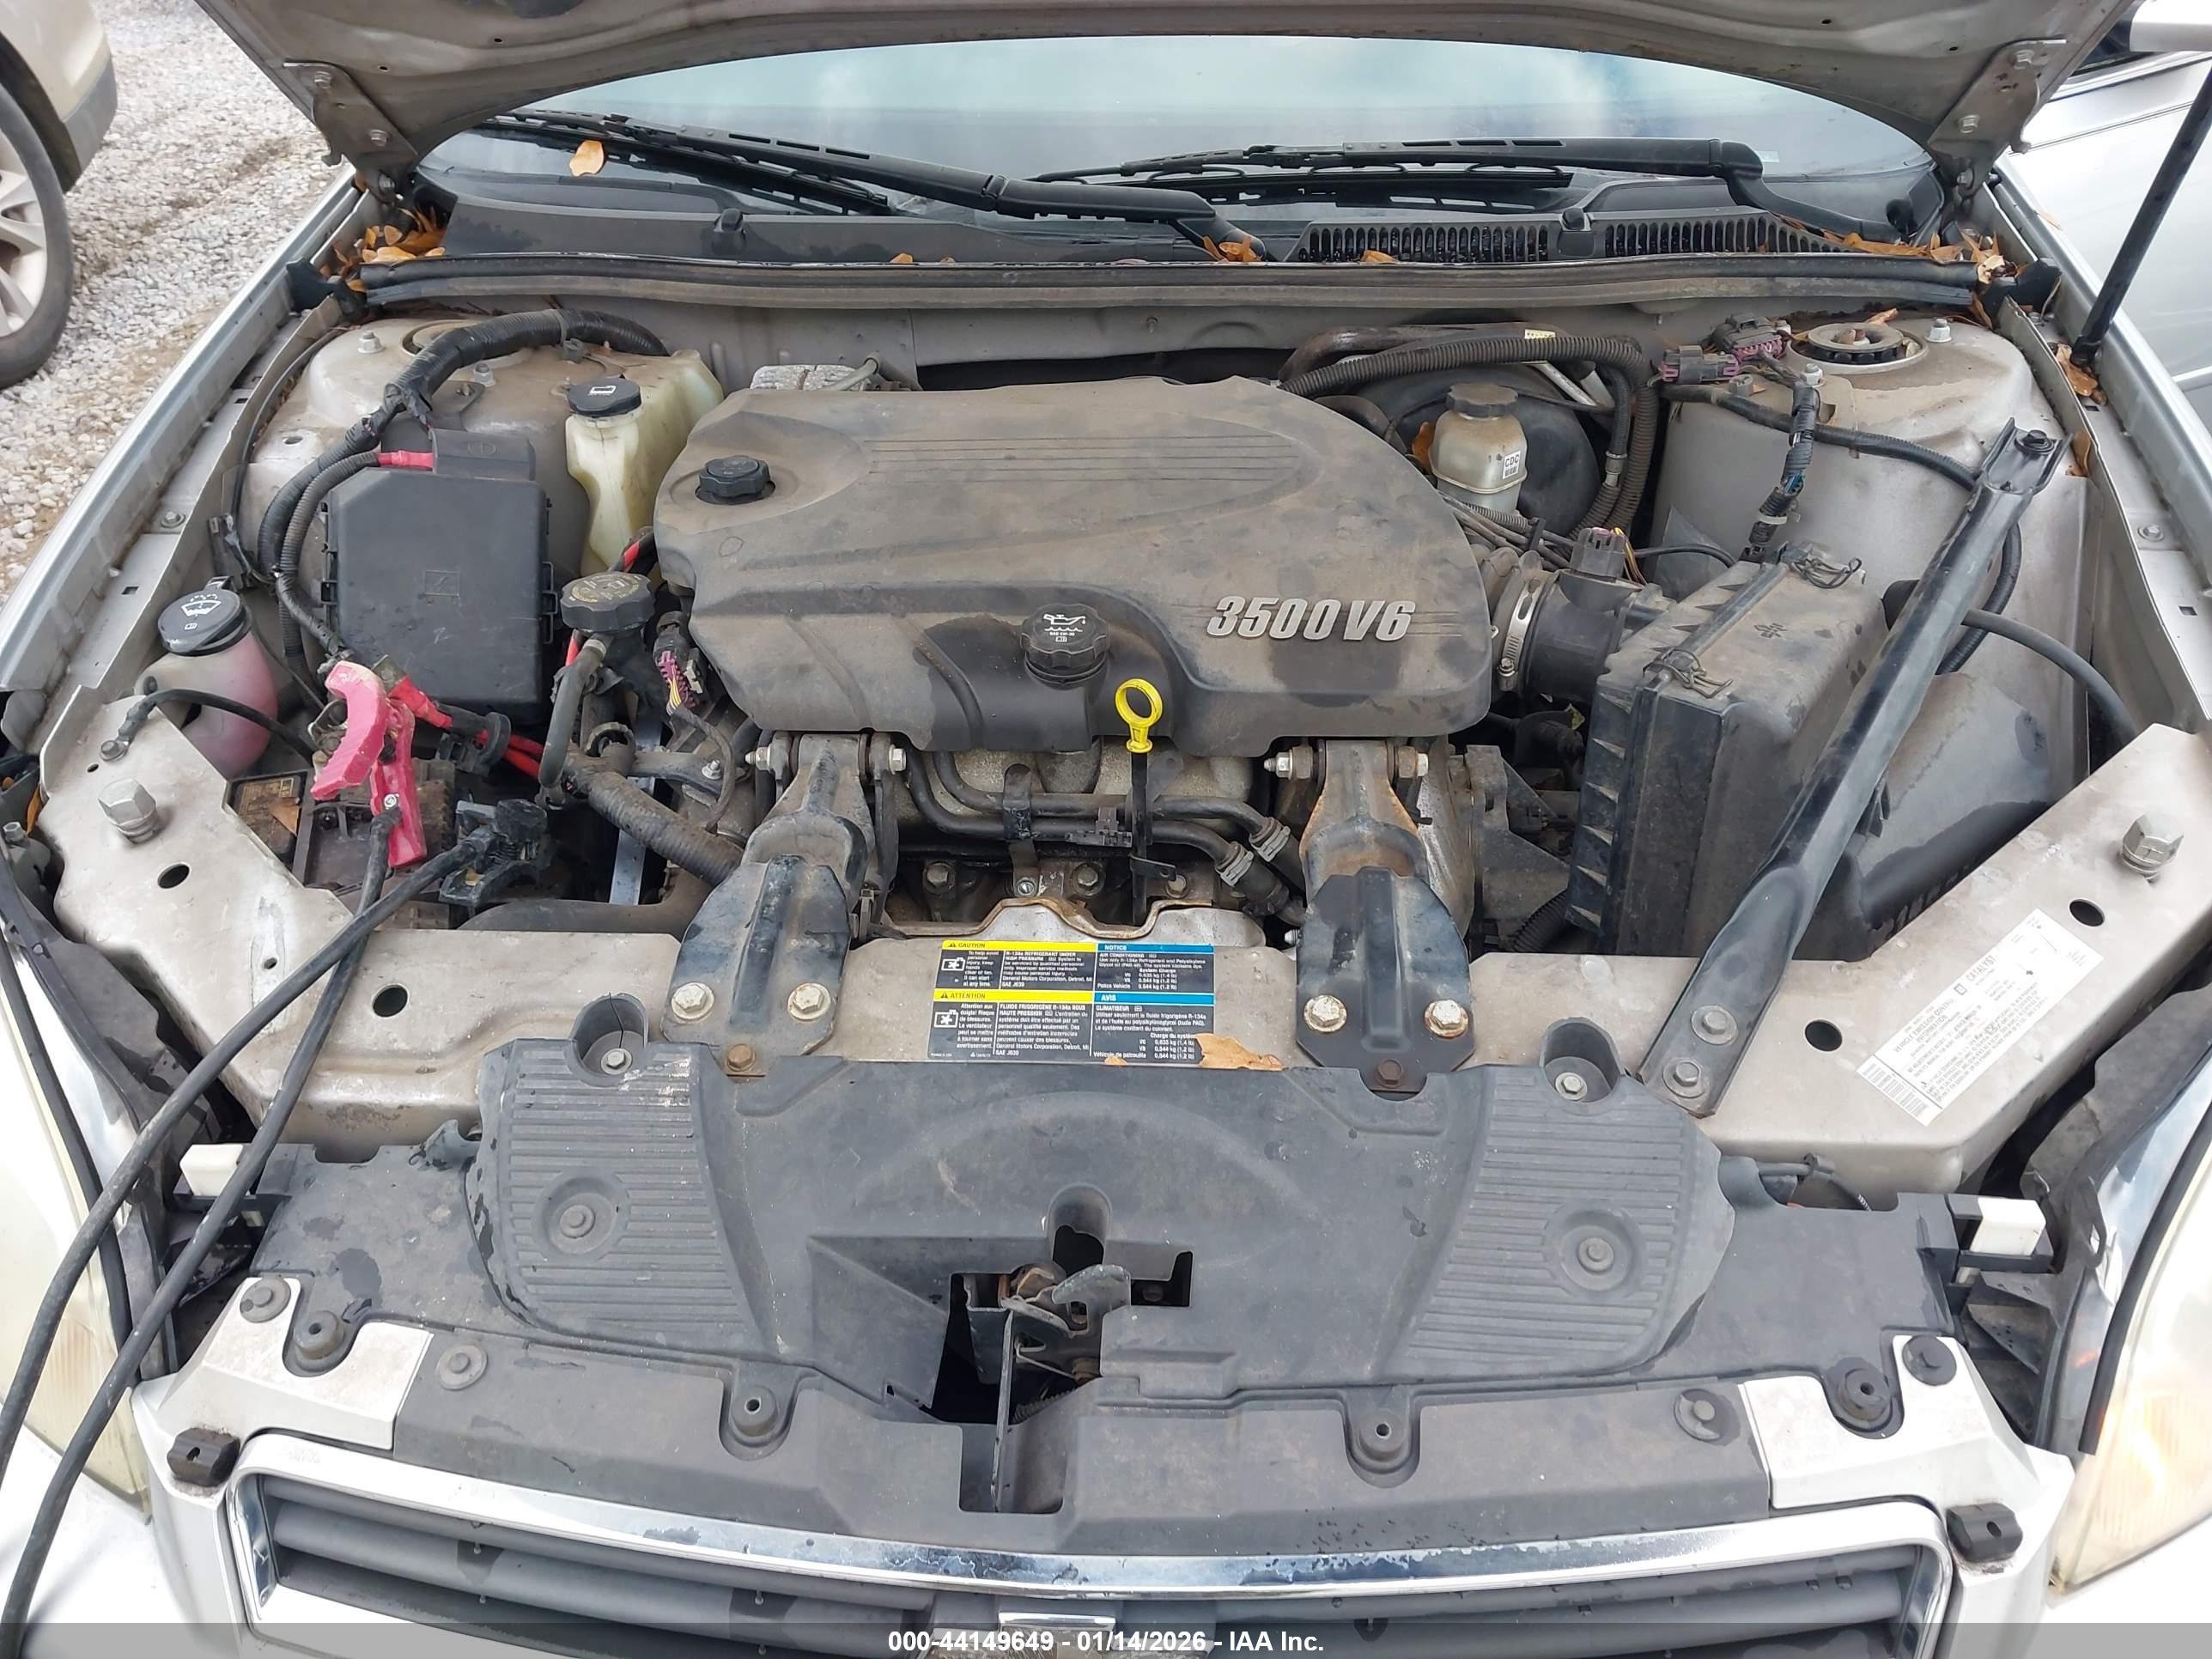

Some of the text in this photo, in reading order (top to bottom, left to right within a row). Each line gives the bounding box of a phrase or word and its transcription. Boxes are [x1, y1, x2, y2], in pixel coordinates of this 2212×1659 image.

[1505, 454, 1519, 467] CDC
[1206, 595, 1416, 641] 3500 V6
[1965, 954, 1996, 981] CATALYST
